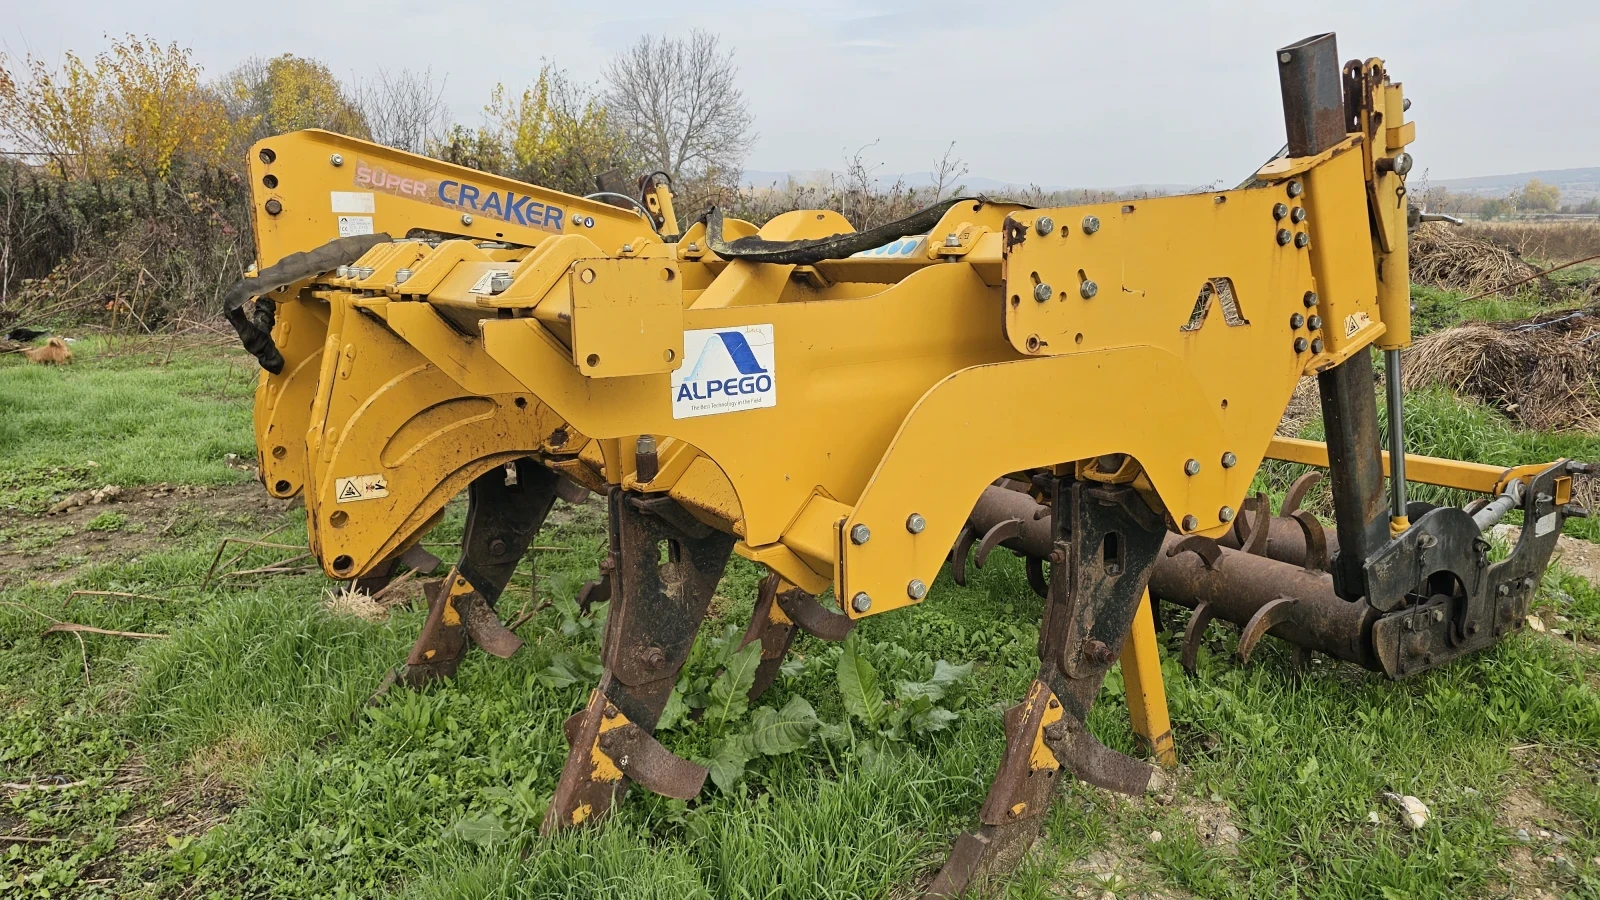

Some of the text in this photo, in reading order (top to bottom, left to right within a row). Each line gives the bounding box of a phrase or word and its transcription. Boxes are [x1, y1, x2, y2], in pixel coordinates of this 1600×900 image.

[356, 167, 427, 197] SUPER
[677, 374, 772, 402] ALPEGO
[711, 401, 737, 409] Technology
